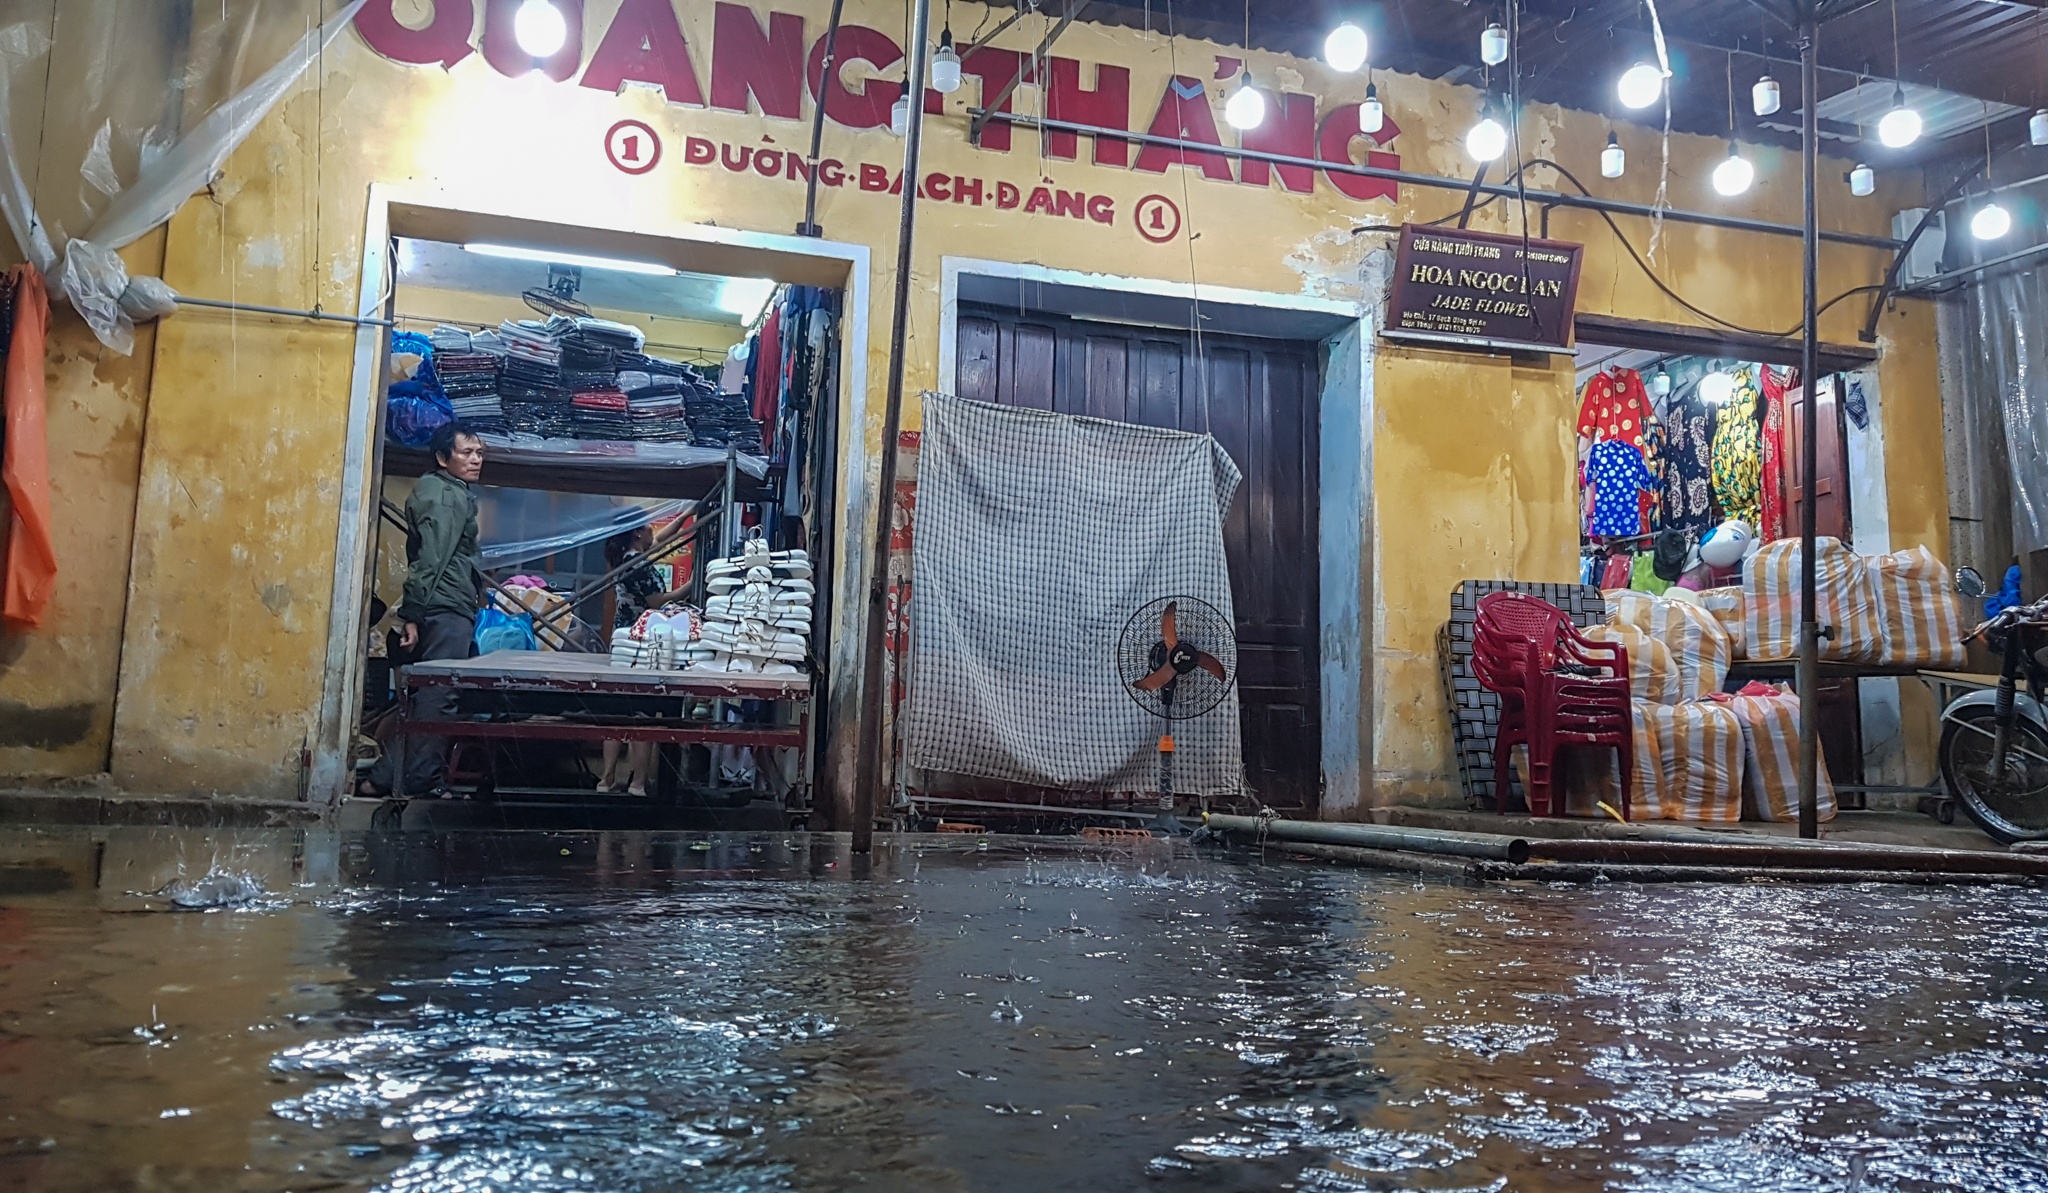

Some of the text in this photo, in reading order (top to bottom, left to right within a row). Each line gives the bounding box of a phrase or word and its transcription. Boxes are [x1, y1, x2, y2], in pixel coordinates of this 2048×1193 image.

[1473, 245, 1501, 259] TRANG
[1548, 254, 1569, 264] SHOP
[1411, 263, 1454, 286] HOA
[1457, 269, 1518, 296] NGỌC
[1431, 294, 1473, 311] JADE
